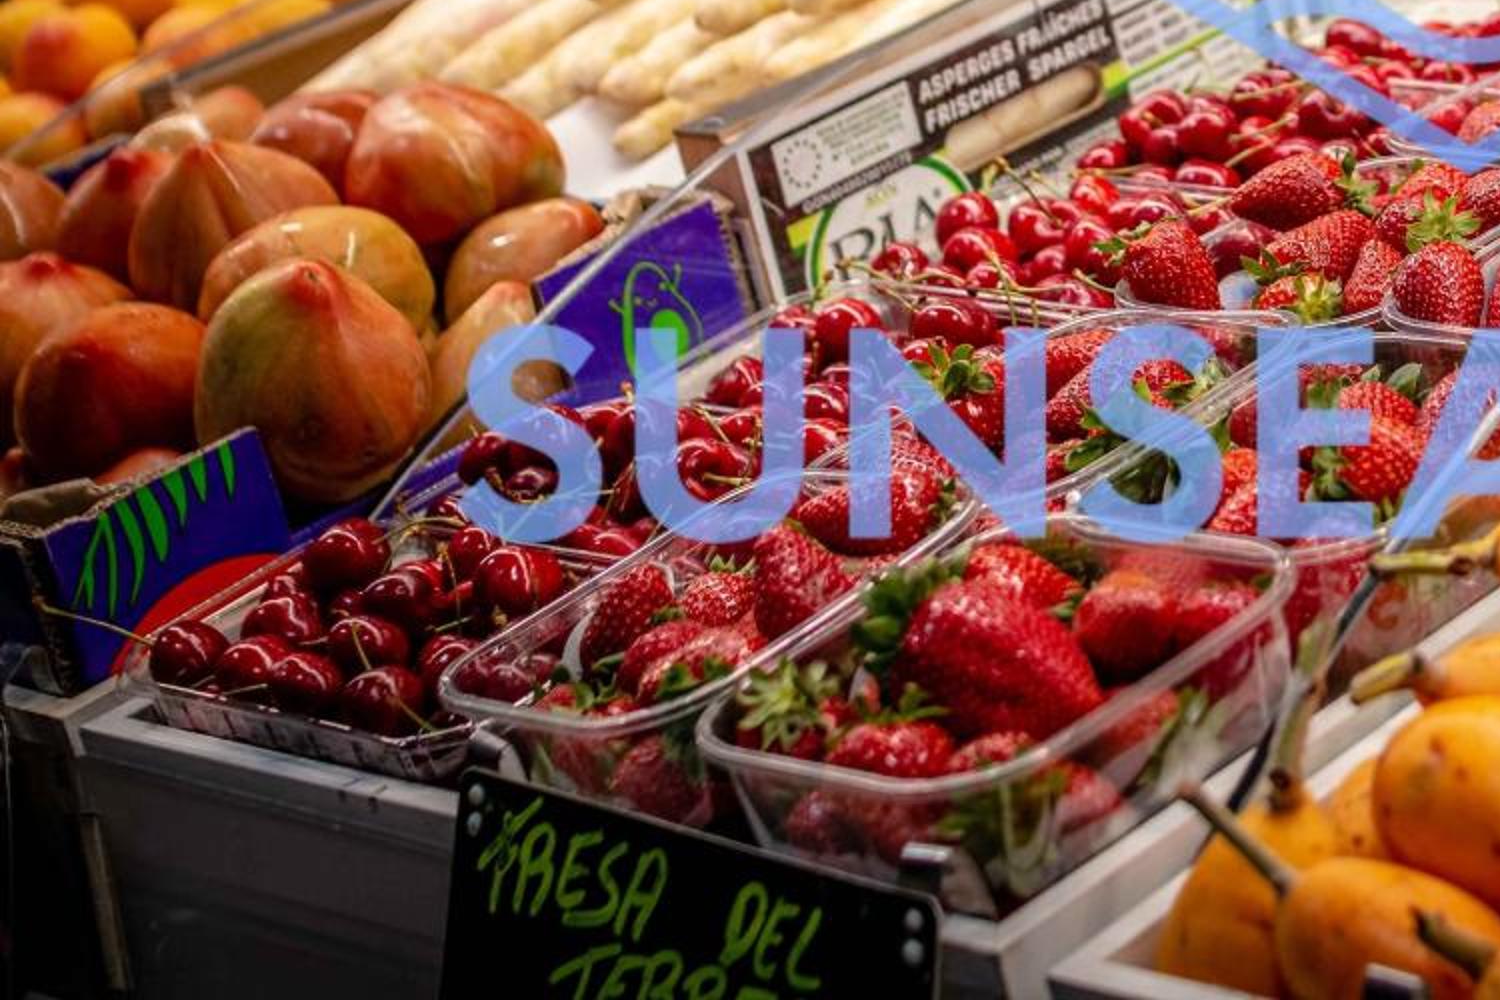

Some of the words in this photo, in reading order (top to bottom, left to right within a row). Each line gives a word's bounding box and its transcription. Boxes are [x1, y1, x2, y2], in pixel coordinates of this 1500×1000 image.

[919, 38, 1015, 104] ASPERGES
[924, 68, 1021, 133] FRISCHER
[1027, 25, 1111, 81] SPARGEL
[477, 797, 668, 942] FRESA
[719, 877, 823, 990] DEL
